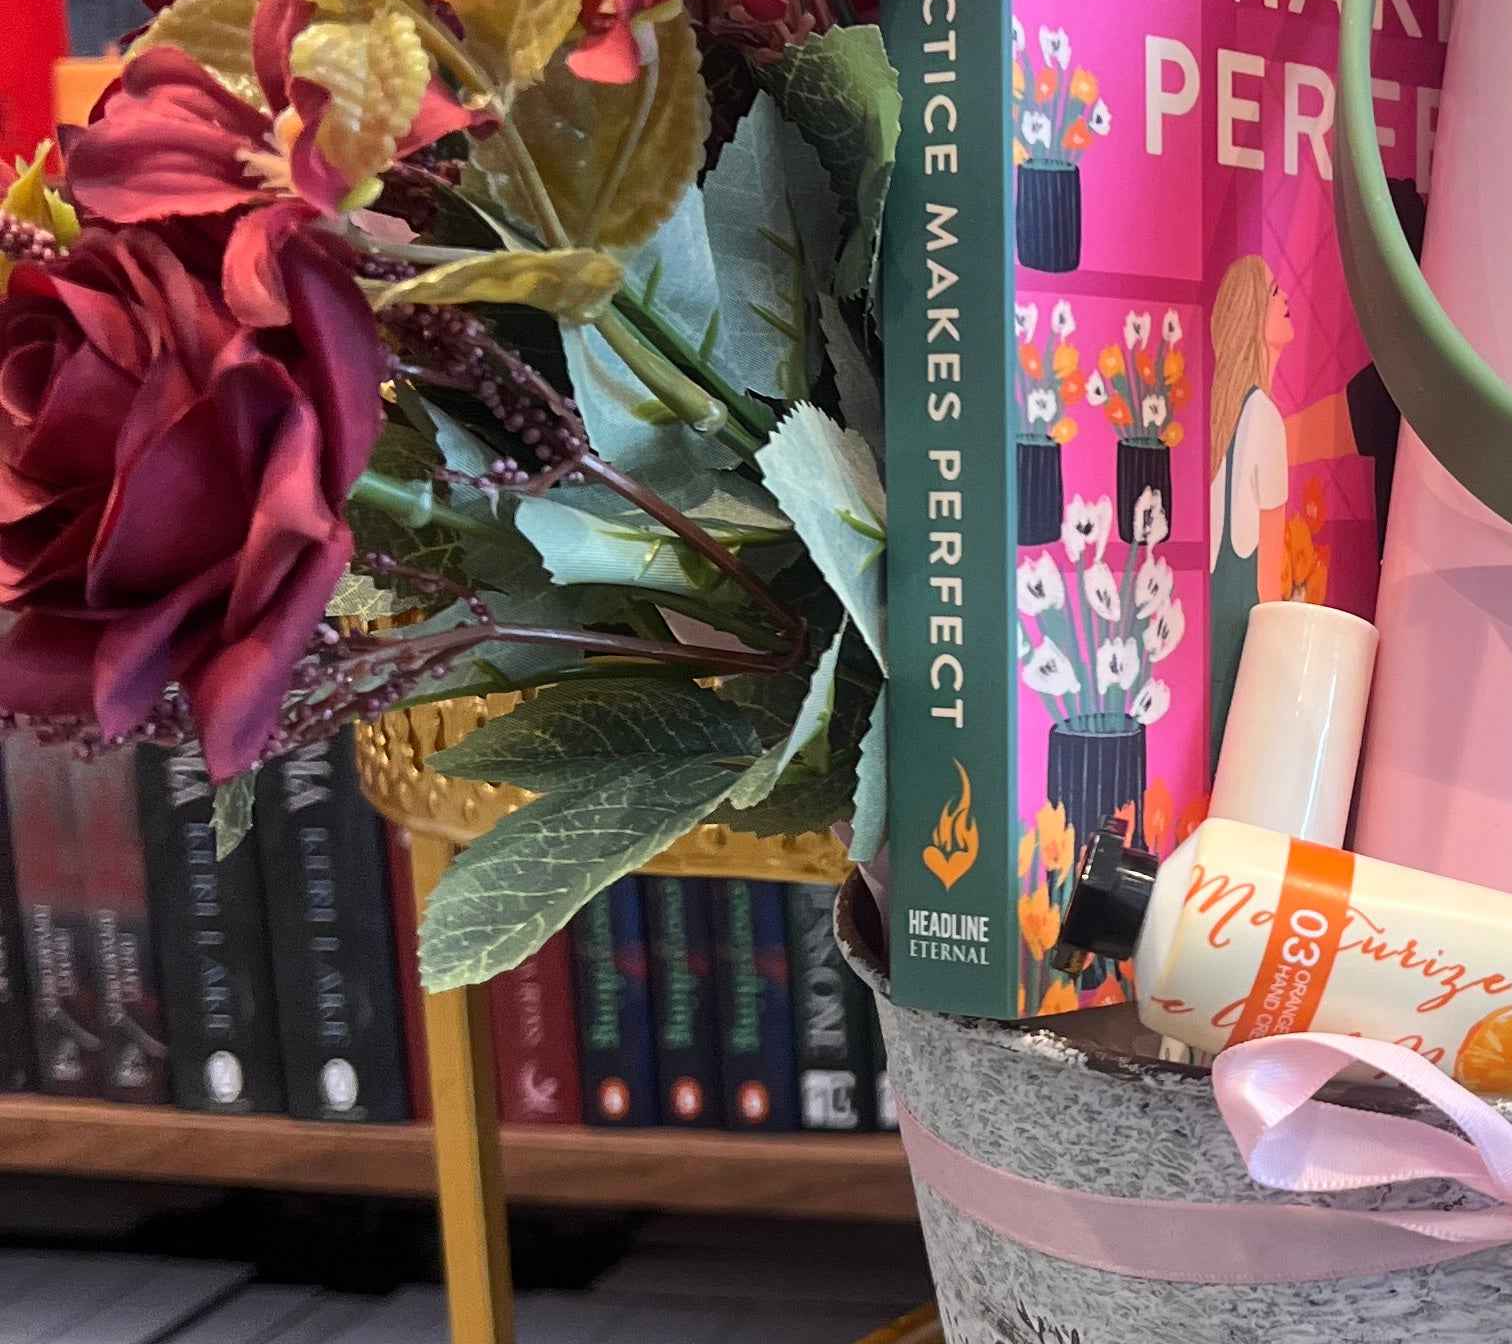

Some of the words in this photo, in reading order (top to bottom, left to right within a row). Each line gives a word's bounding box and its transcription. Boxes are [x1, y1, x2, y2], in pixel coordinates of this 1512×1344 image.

[925, 203, 961, 422] MAKES
[927, 449, 964, 729] PERFECT
[908, 907, 990, 943] HEADLINE
[909, 939, 990, 966] ETERNAL
[1282, 908, 1329, 967] 03
[1263, 964, 1292, 1011] HAND
[1272, 968, 1311, 1033] ORANGE
